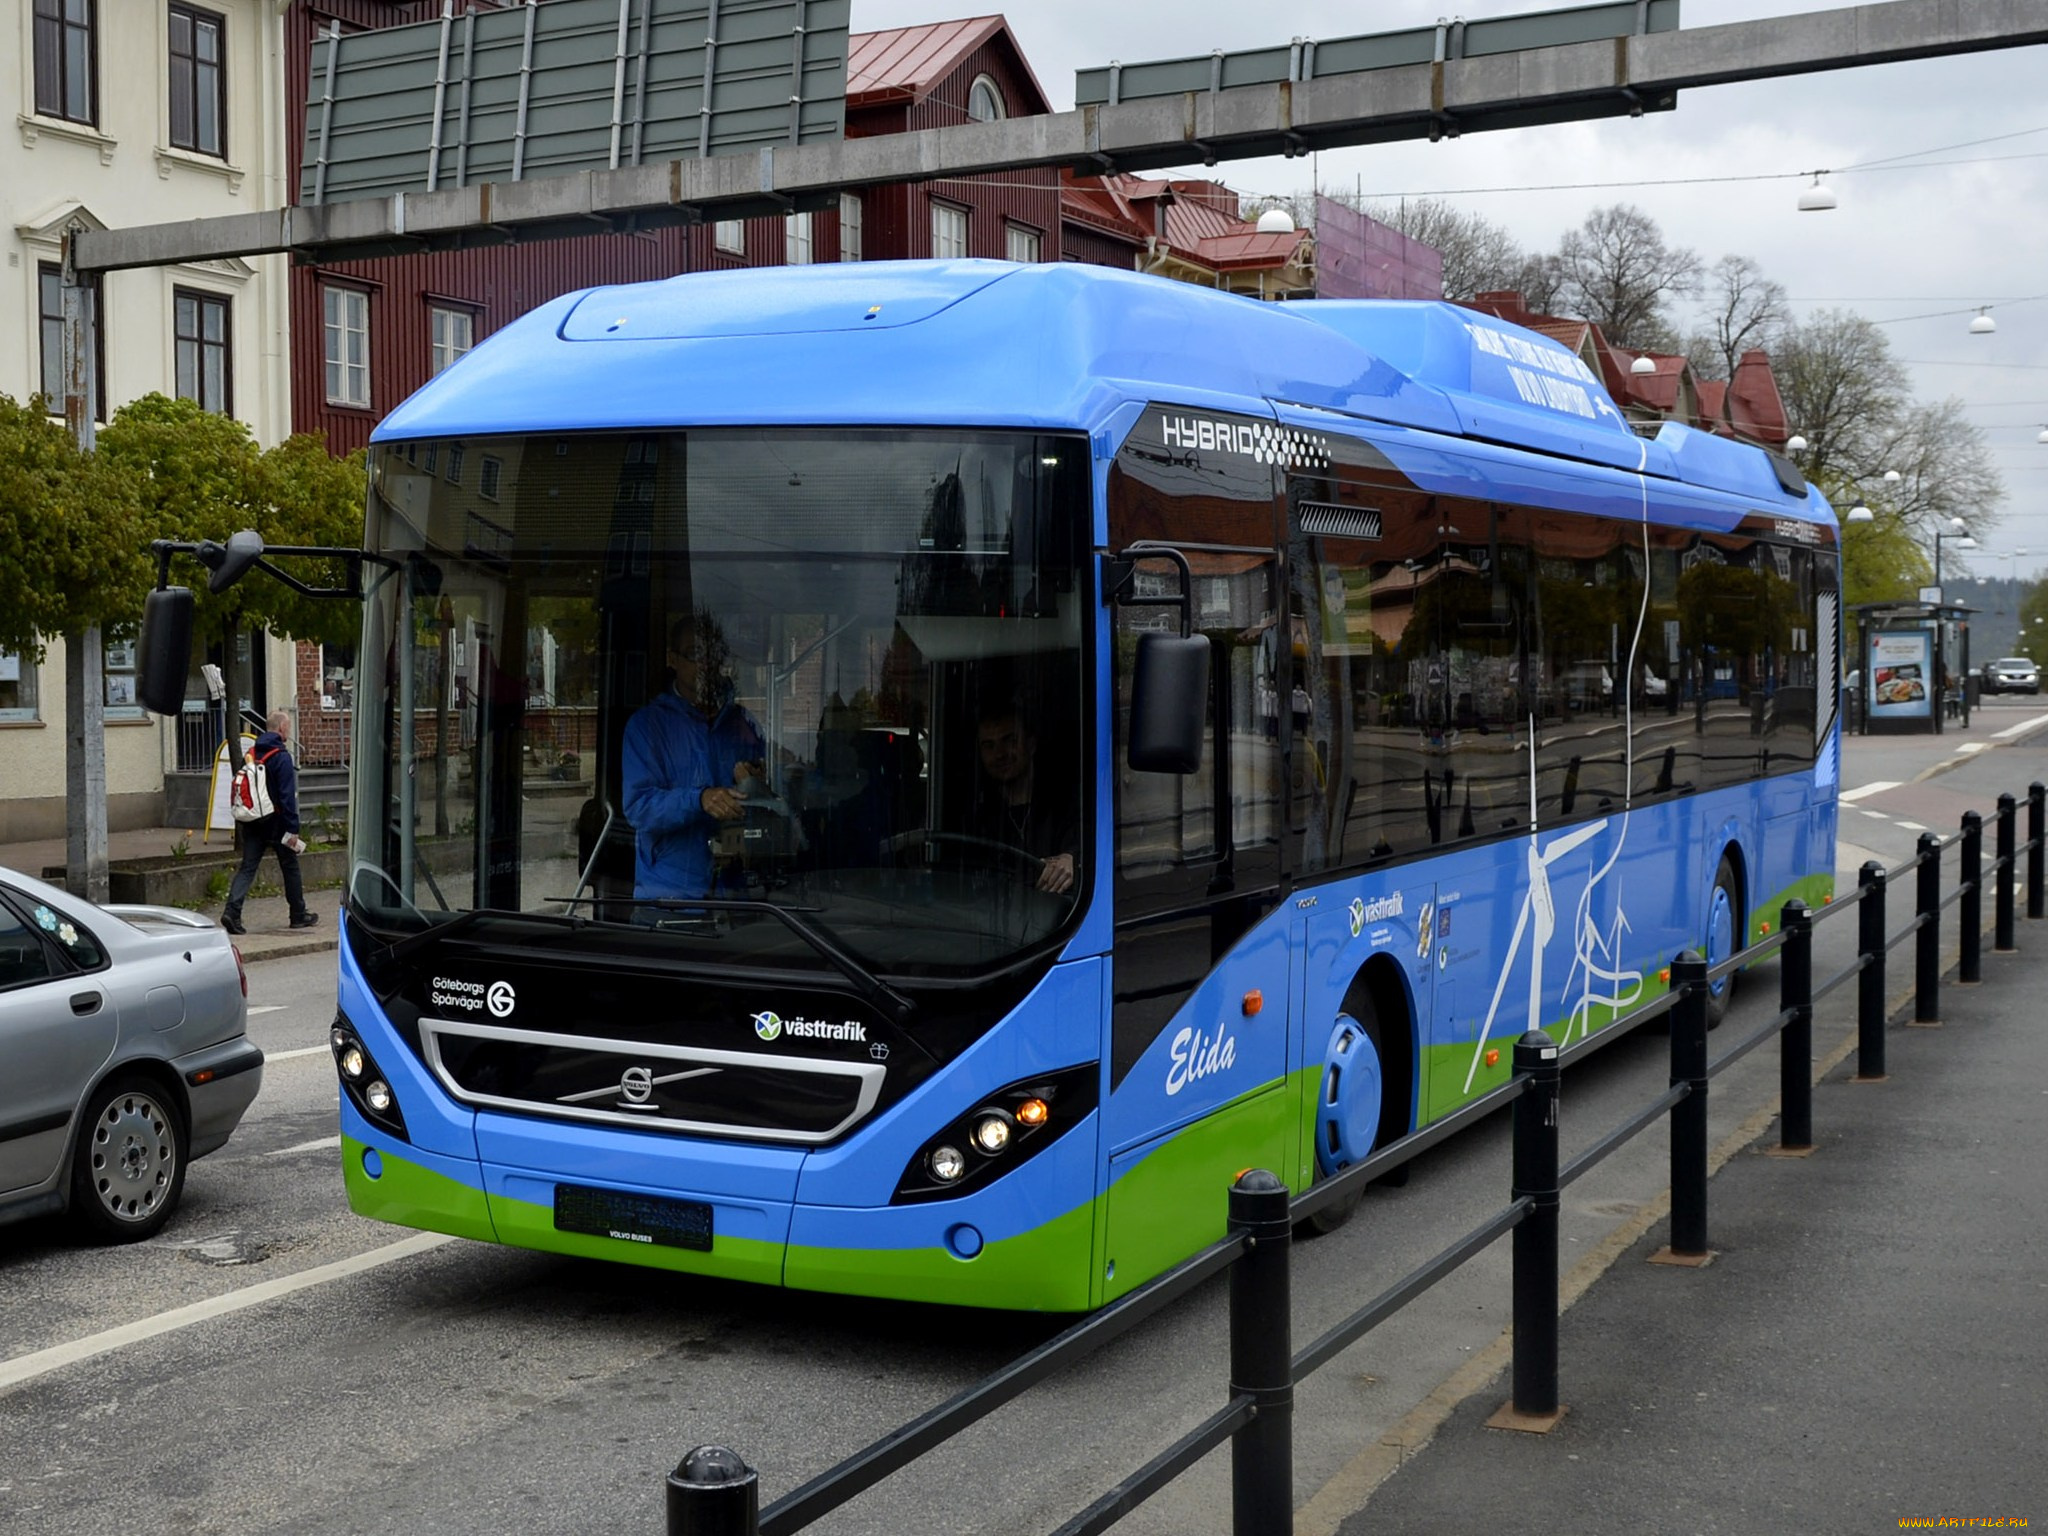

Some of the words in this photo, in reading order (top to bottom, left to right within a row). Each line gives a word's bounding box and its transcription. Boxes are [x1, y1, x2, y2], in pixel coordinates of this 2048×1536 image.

[1162, 415, 1254, 455] HYBRID
[432, 976, 485, 996] Göteborgs
[431, 991, 484, 1011] Spårvägar
[784, 1016, 867, 1042] västtrafik
[1165, 1022, 1237, 1096] Elida
[623, 1080, 650, 1090] VOLVO
[609, 1230, 630, 1240] VOLVO
[631, 1233, 652, 1243] BUSES
